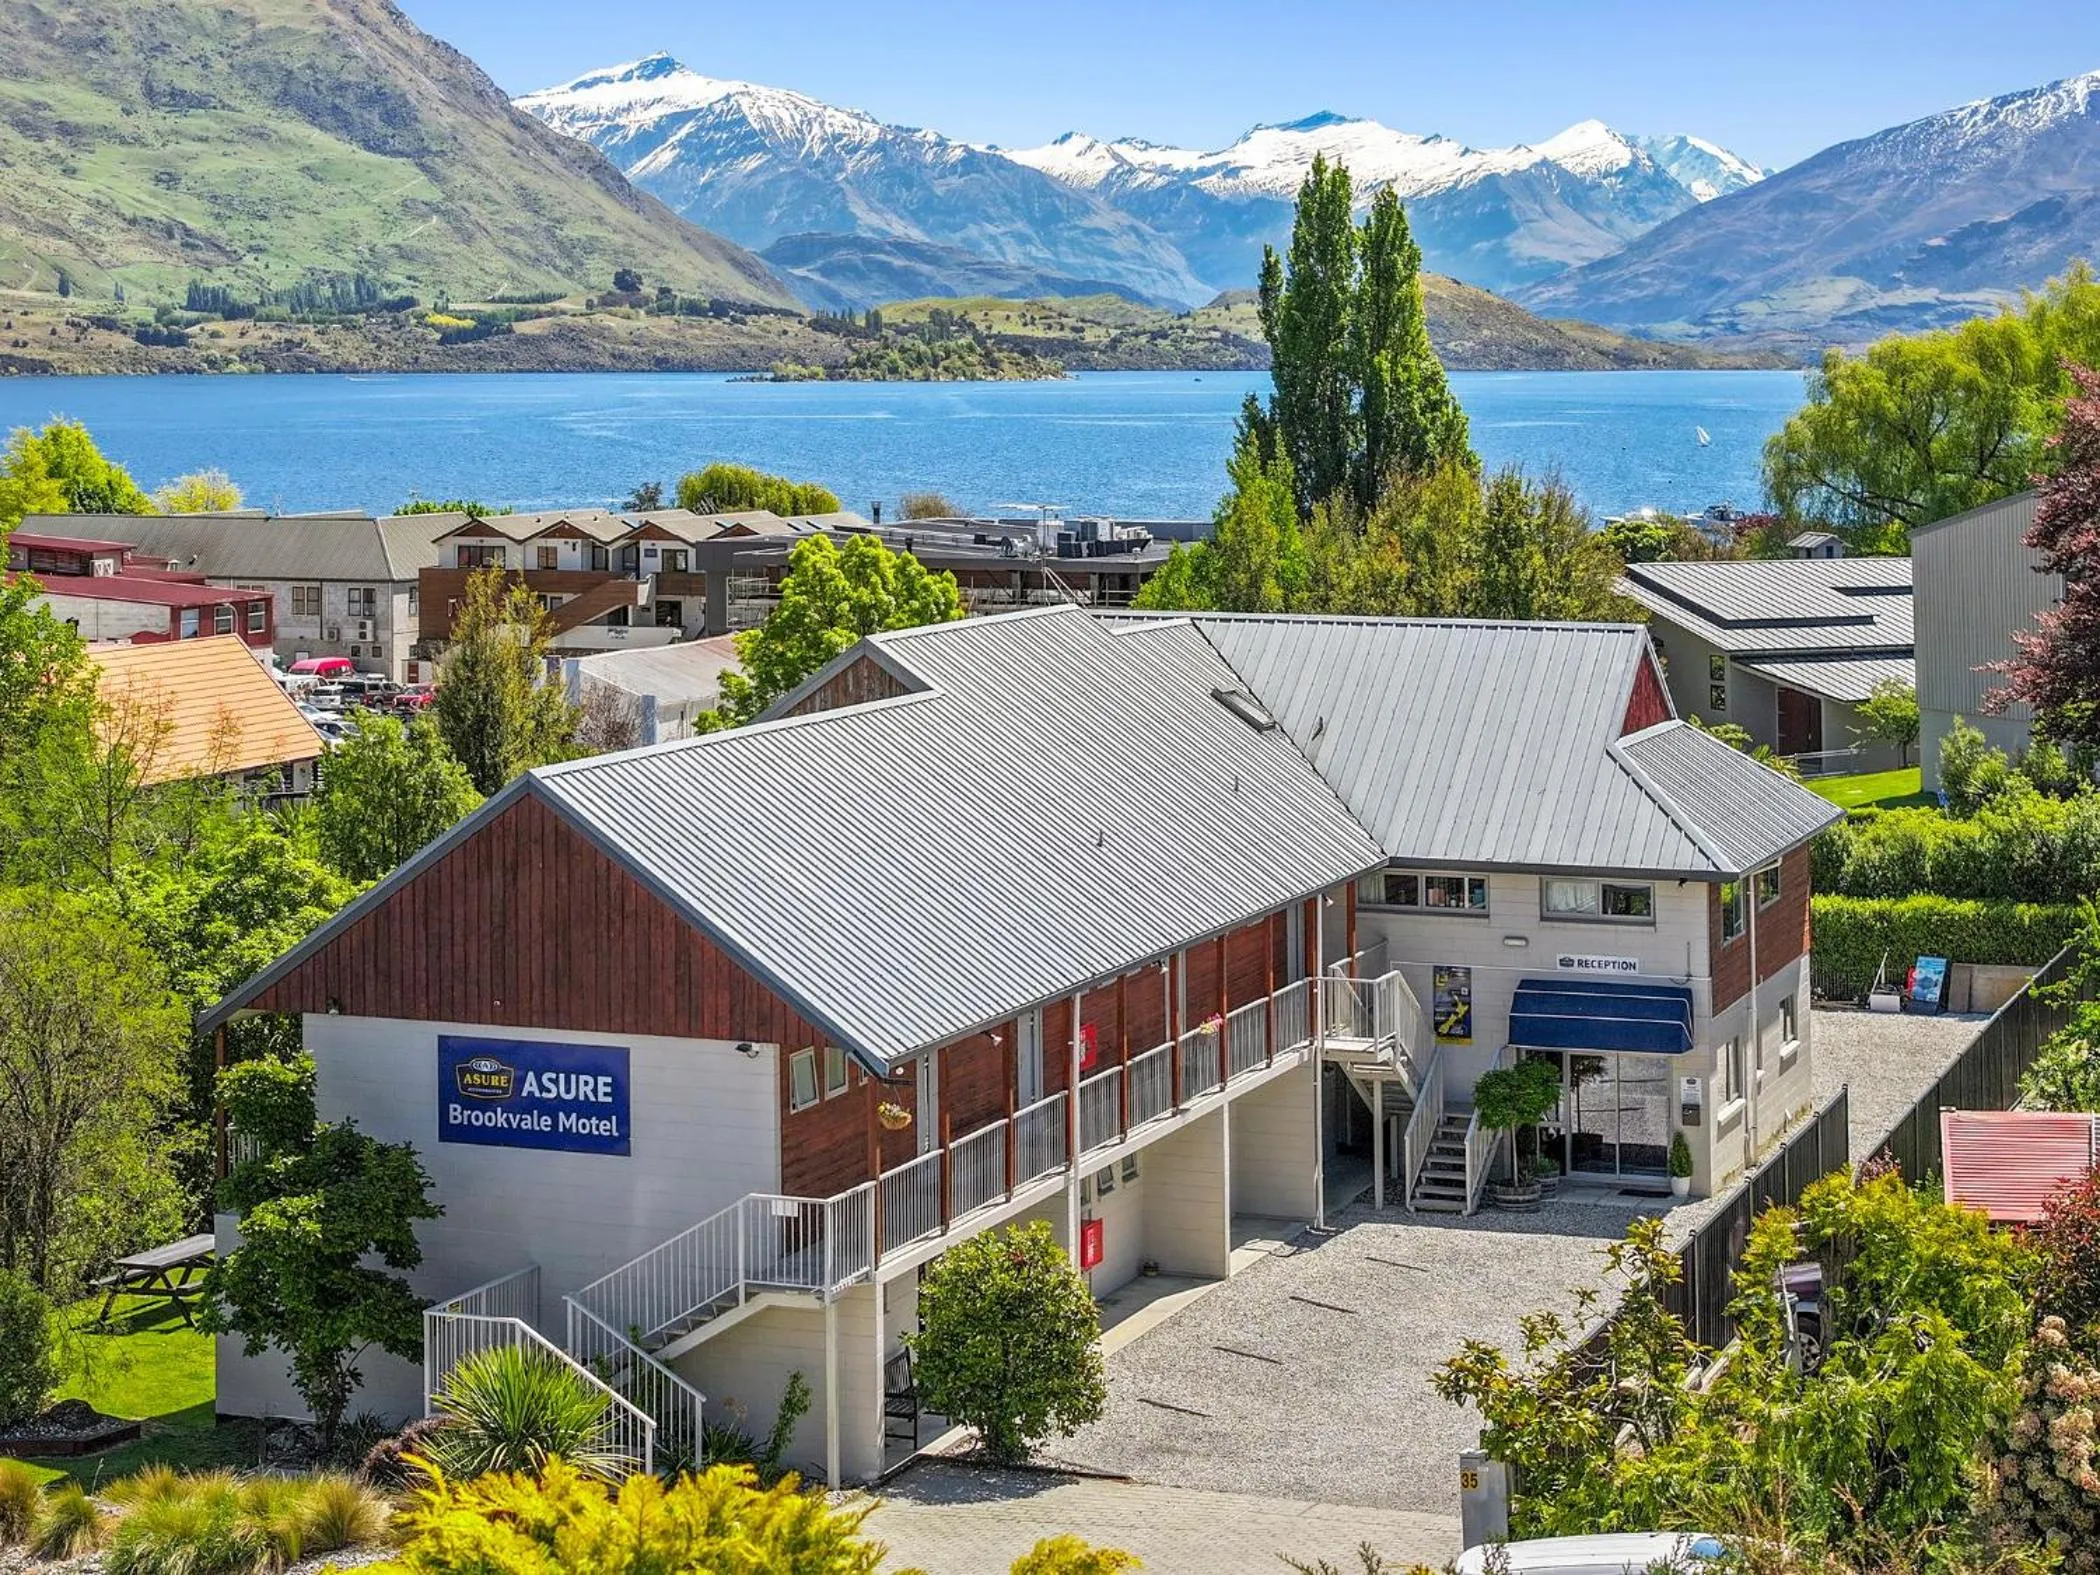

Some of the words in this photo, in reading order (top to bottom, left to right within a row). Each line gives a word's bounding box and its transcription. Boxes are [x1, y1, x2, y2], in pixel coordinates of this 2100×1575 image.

[1577, 958, 1636, 971] RECEPTION
[463, 1072, 509, 1087] ASURE
[521, 1070, 612, 1103] ASURE
[449, 1103, 552, 1132] Brookvale
[558, 1111, 619, 1137] Motel
[1461, 1472, 1478, 1489] 35
